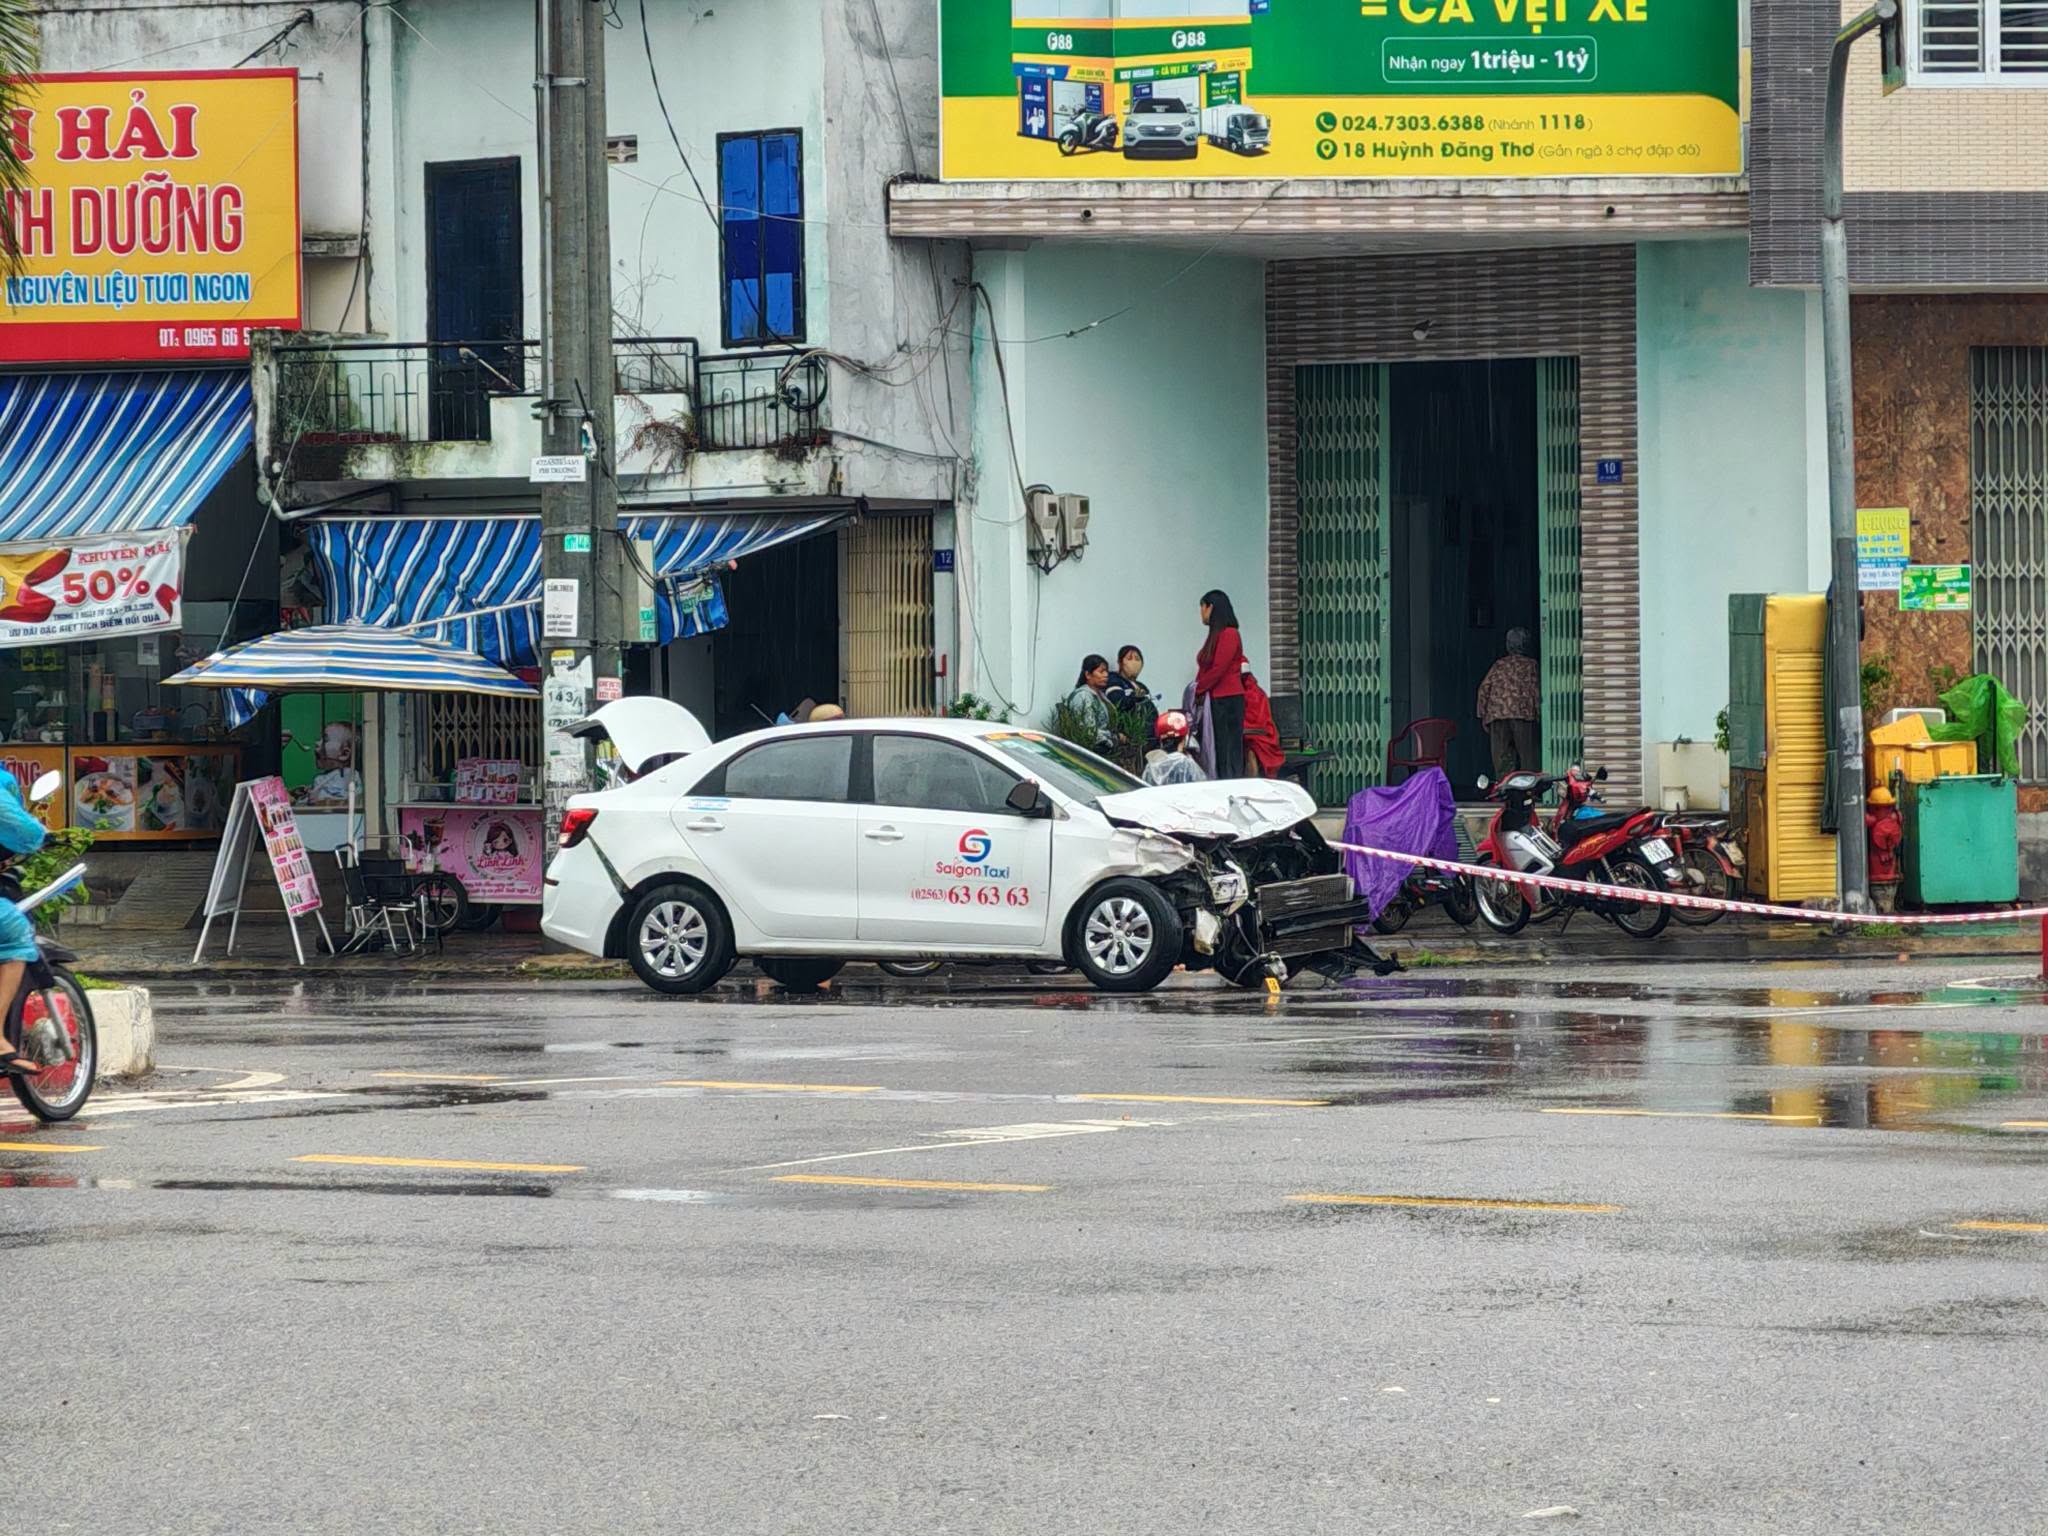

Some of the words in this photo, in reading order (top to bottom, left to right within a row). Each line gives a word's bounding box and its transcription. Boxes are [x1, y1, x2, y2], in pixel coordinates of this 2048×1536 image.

[1172, 30, 1206, 49] F88
[1389, 55, 1427, 72] Nhận
[1431, 58, 1465, 74] ngay
[1471, 50, 1535, 74] 1triệu
[1554, 47, 1589, 74] 1tỷ
[56, 90, 199, 161] HẢI
[1342, 115, 1485, 131] 024.7303.6388
[1344, 142, 1366, 158] 18
[1372, 141, 1434, 161] Huỳnh
[1440, 141, 1494, 161] Đăng
[1500, 140, 1535, 157] Thơ
[70, 171, 244, 257] DƯỠNG
[6, 271, 88, 305] NGUYÊN
[93, 269, 138, 310] LIỆU
[143, 271, 188, 304] TƯƠI
[193, 270, 251, 303] NGON
[1604, 462, 1616, 474] 10
[940, 552, 952, 564] 12
[62, 564, 150, 607] 50%
[935, 860, 982, 878] Saigon
[983, 864, 1010, 879] Taxi
[948, 885, 971, 905] 63
[977, 885, 1000, 906] 63
[1006, 886, 1030, 906] 63
